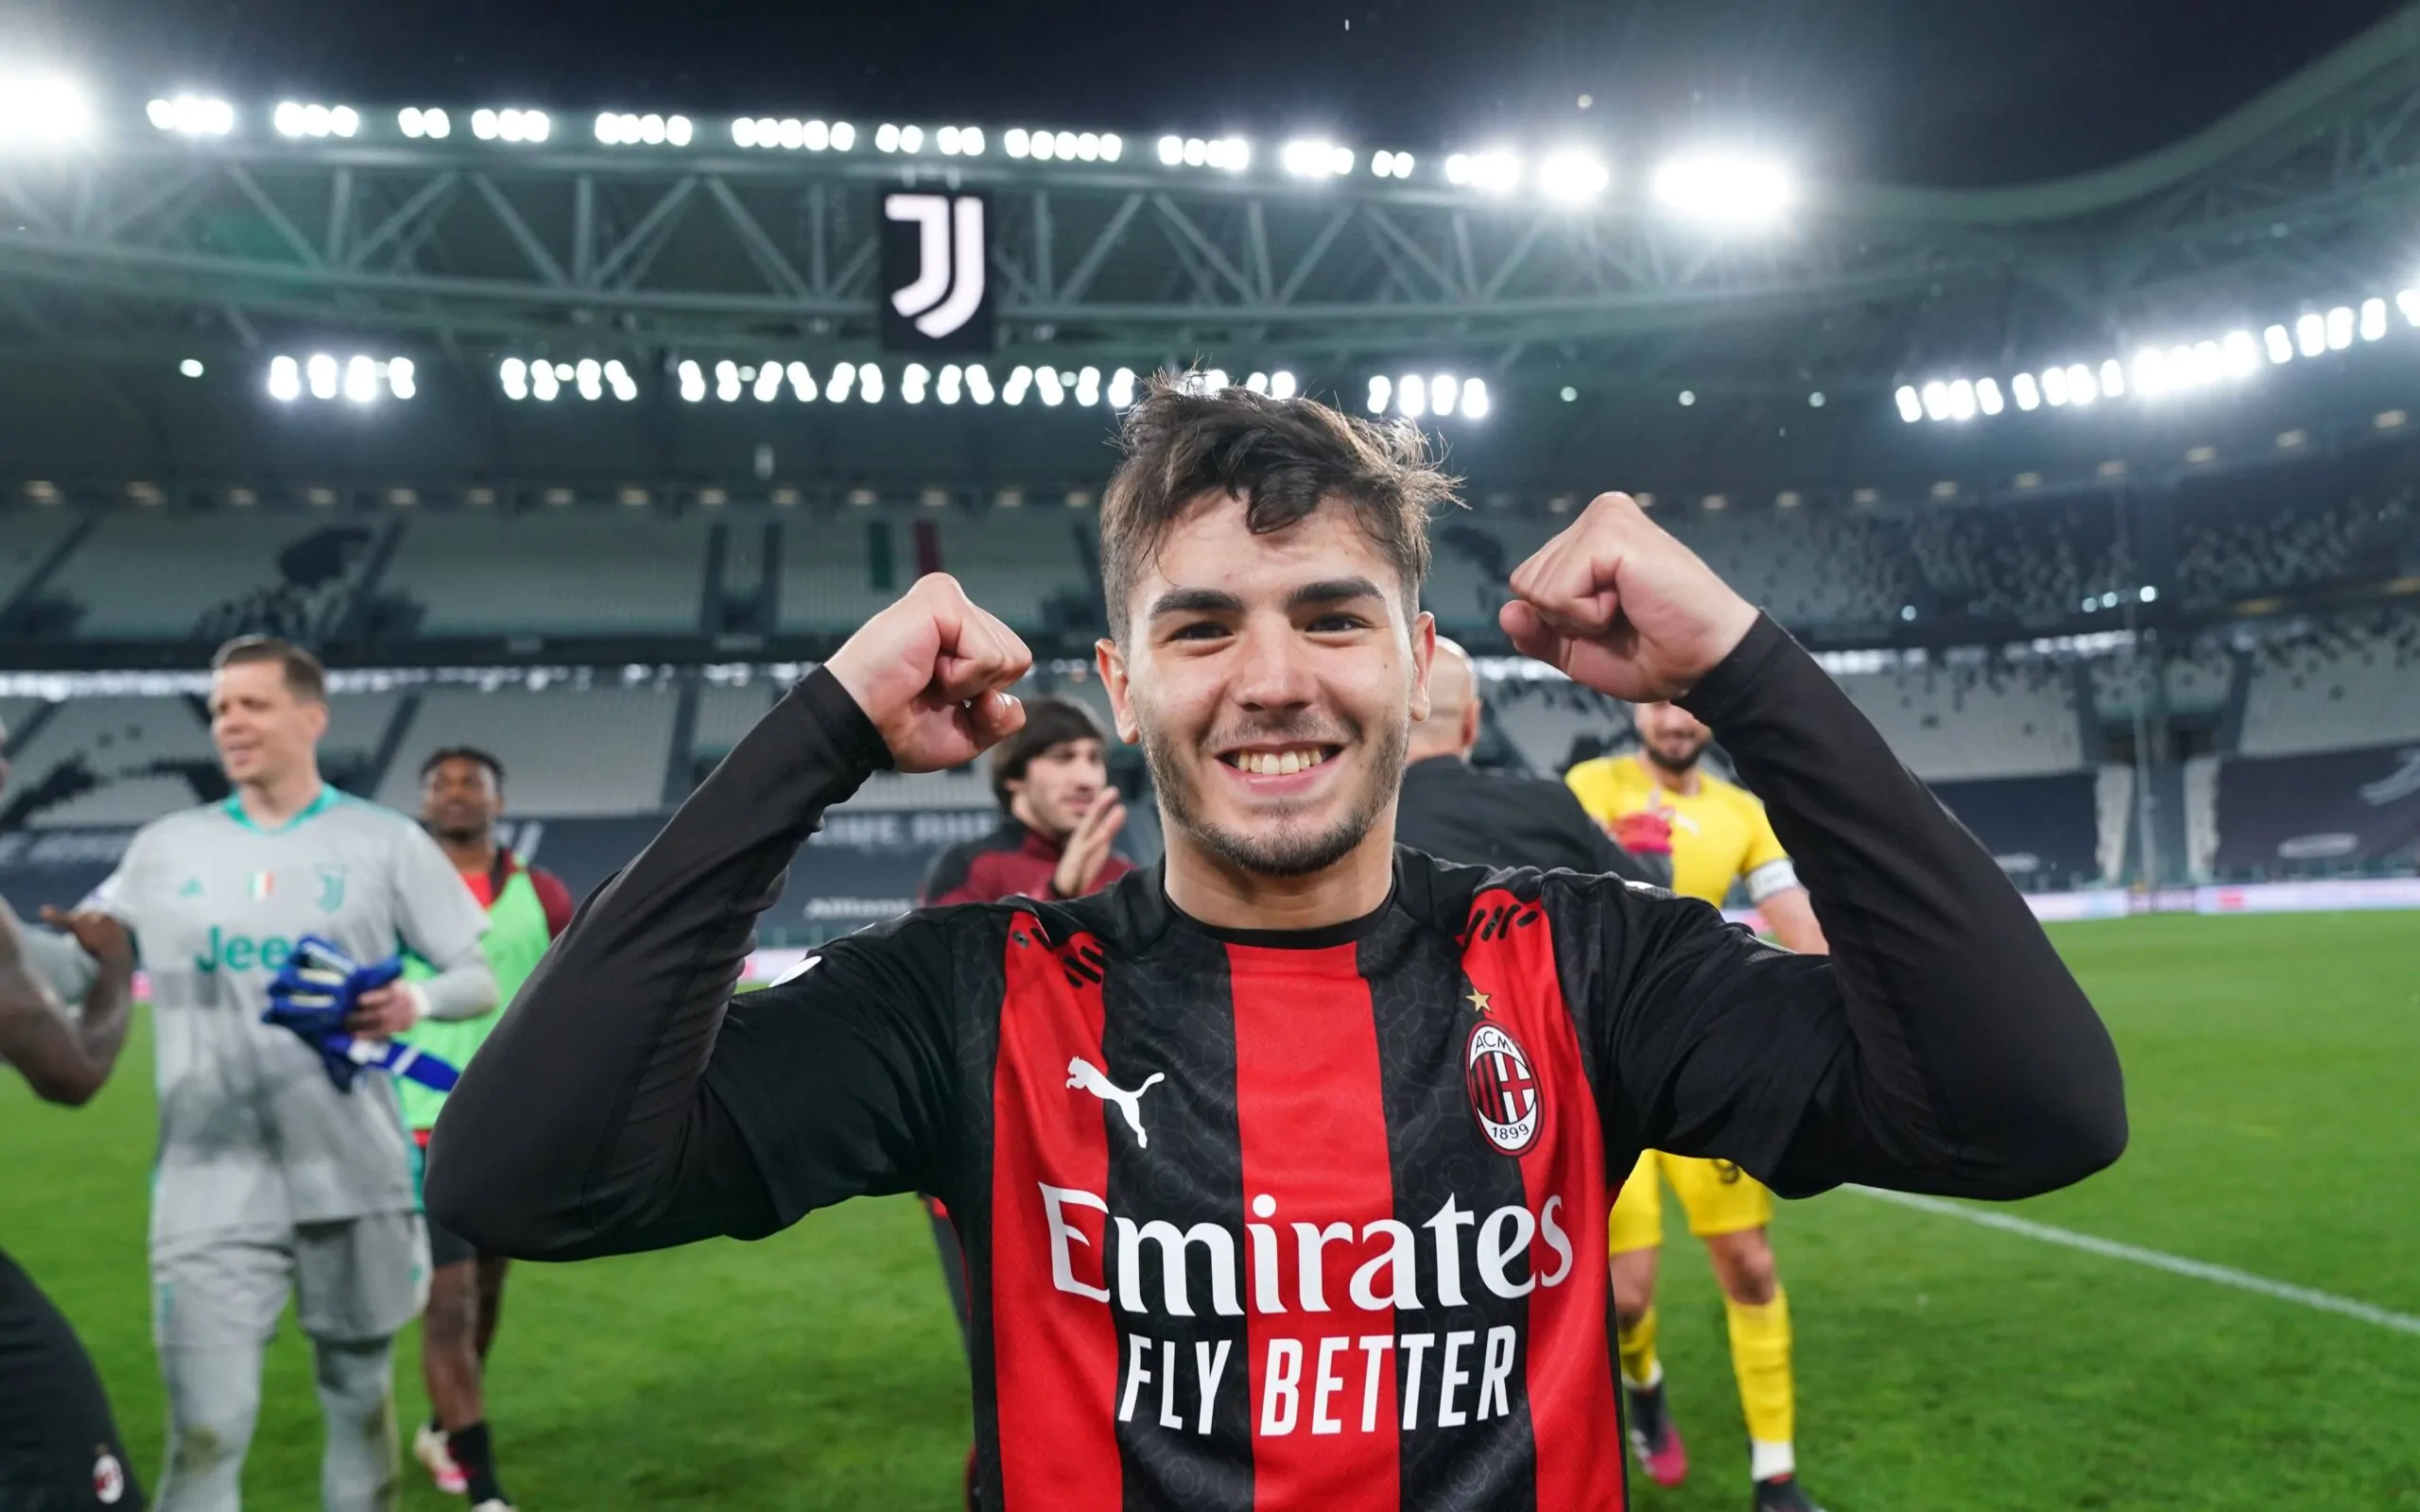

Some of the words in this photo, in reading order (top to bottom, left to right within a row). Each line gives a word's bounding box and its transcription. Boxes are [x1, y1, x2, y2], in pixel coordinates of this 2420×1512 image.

[195, 925, 293, 974] Jee
[1475, 1030, 1512, 1054] ACM
[1492, 1123, 1530, 1141] 1899
[1038, 1181, 1573, 1316] Emirates
[1118, 1333, 1232, 1435] FLY
[1259, 1325, 1516, 1436] BETTER
